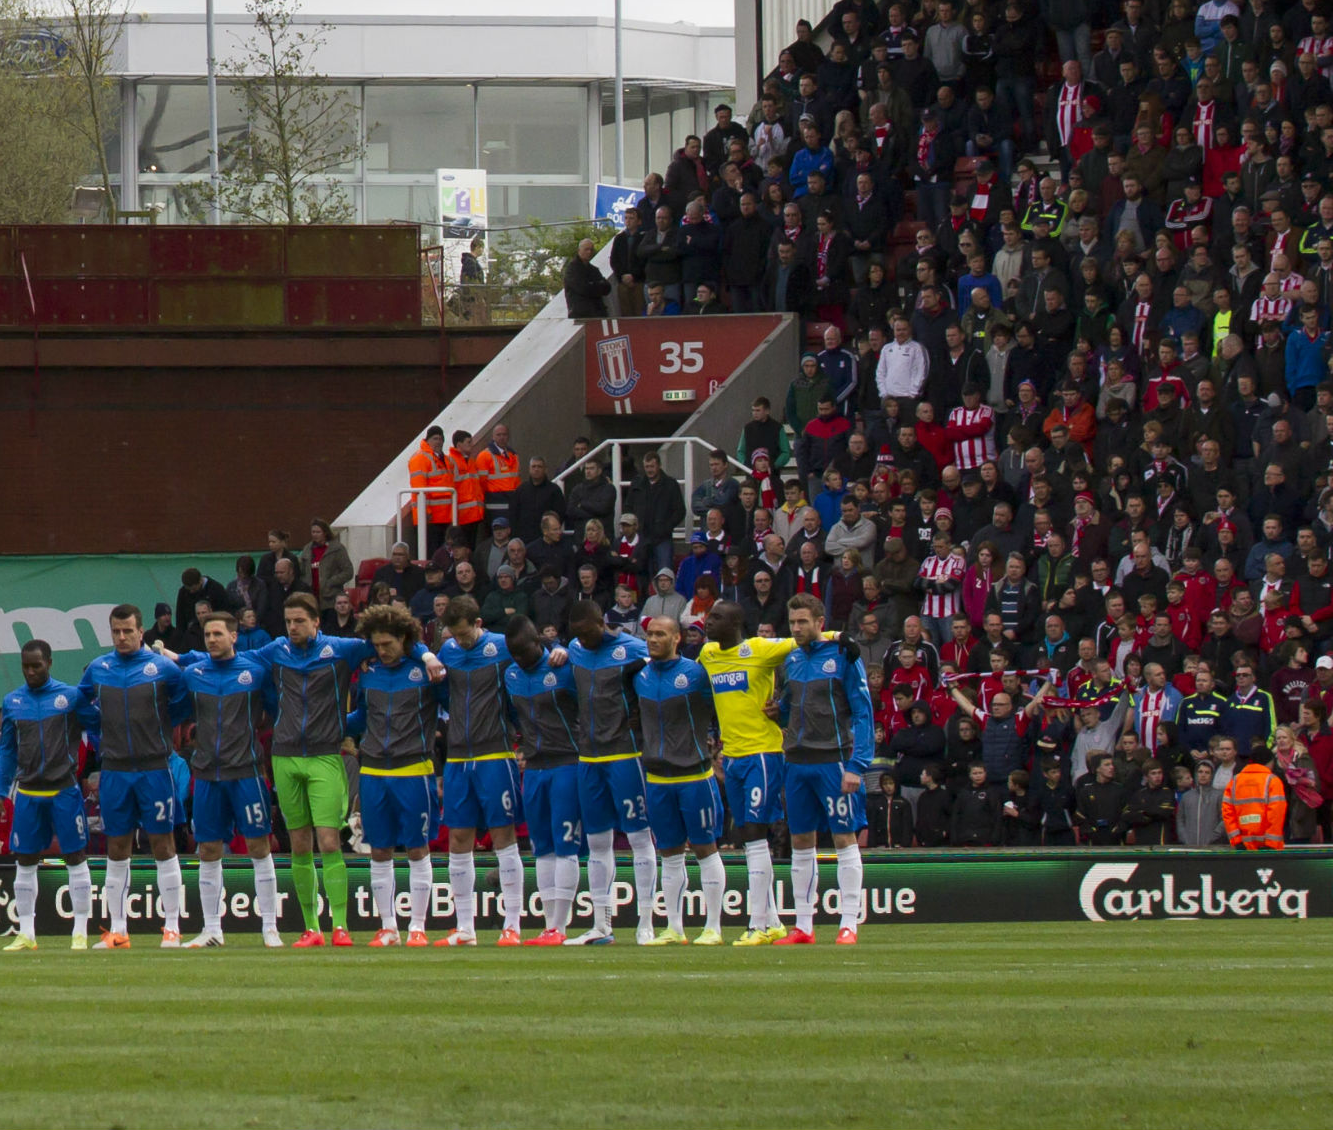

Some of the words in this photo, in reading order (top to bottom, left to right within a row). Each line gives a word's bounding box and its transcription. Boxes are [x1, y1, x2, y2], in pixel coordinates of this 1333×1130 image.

[659, 341, 704, 374] 35
[501, 790, 512, 811] 6
[750, 786, 762, 807] 9
[245, 802, 264, 824] 15
[700, 807, 714, 828] 11
[1079, 862, 1309, 922] Carlsberg
